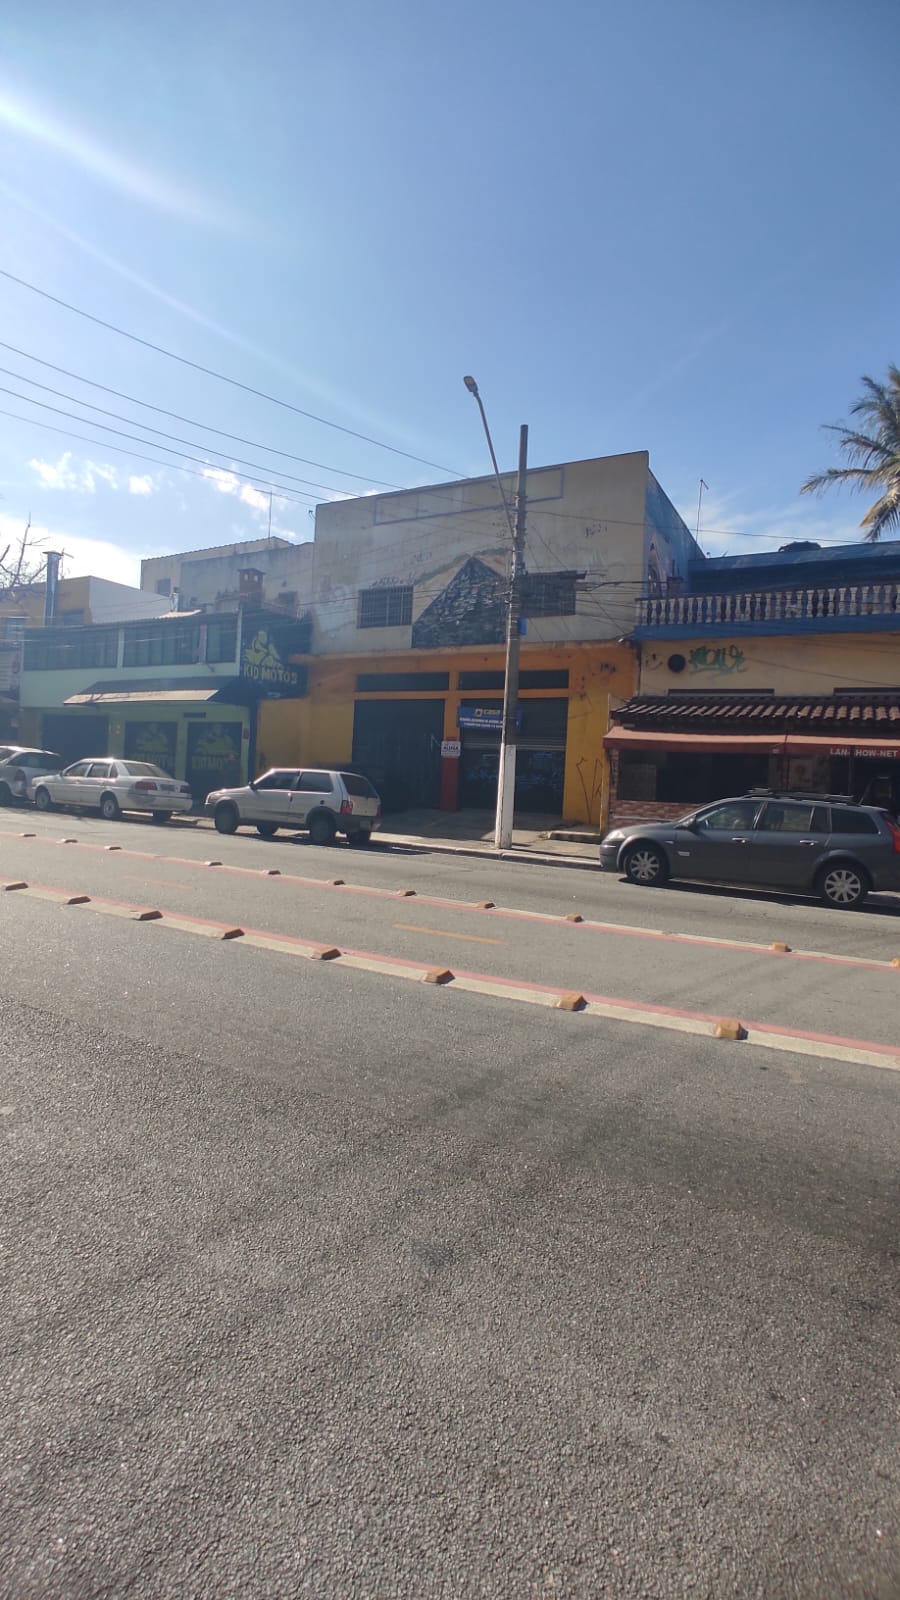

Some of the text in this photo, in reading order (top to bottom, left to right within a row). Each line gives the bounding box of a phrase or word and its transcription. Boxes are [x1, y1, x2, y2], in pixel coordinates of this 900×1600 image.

[243, 664, 298, 684] KID MOTOS
[830, 748, 898, 757] LAN-HOW-NET
